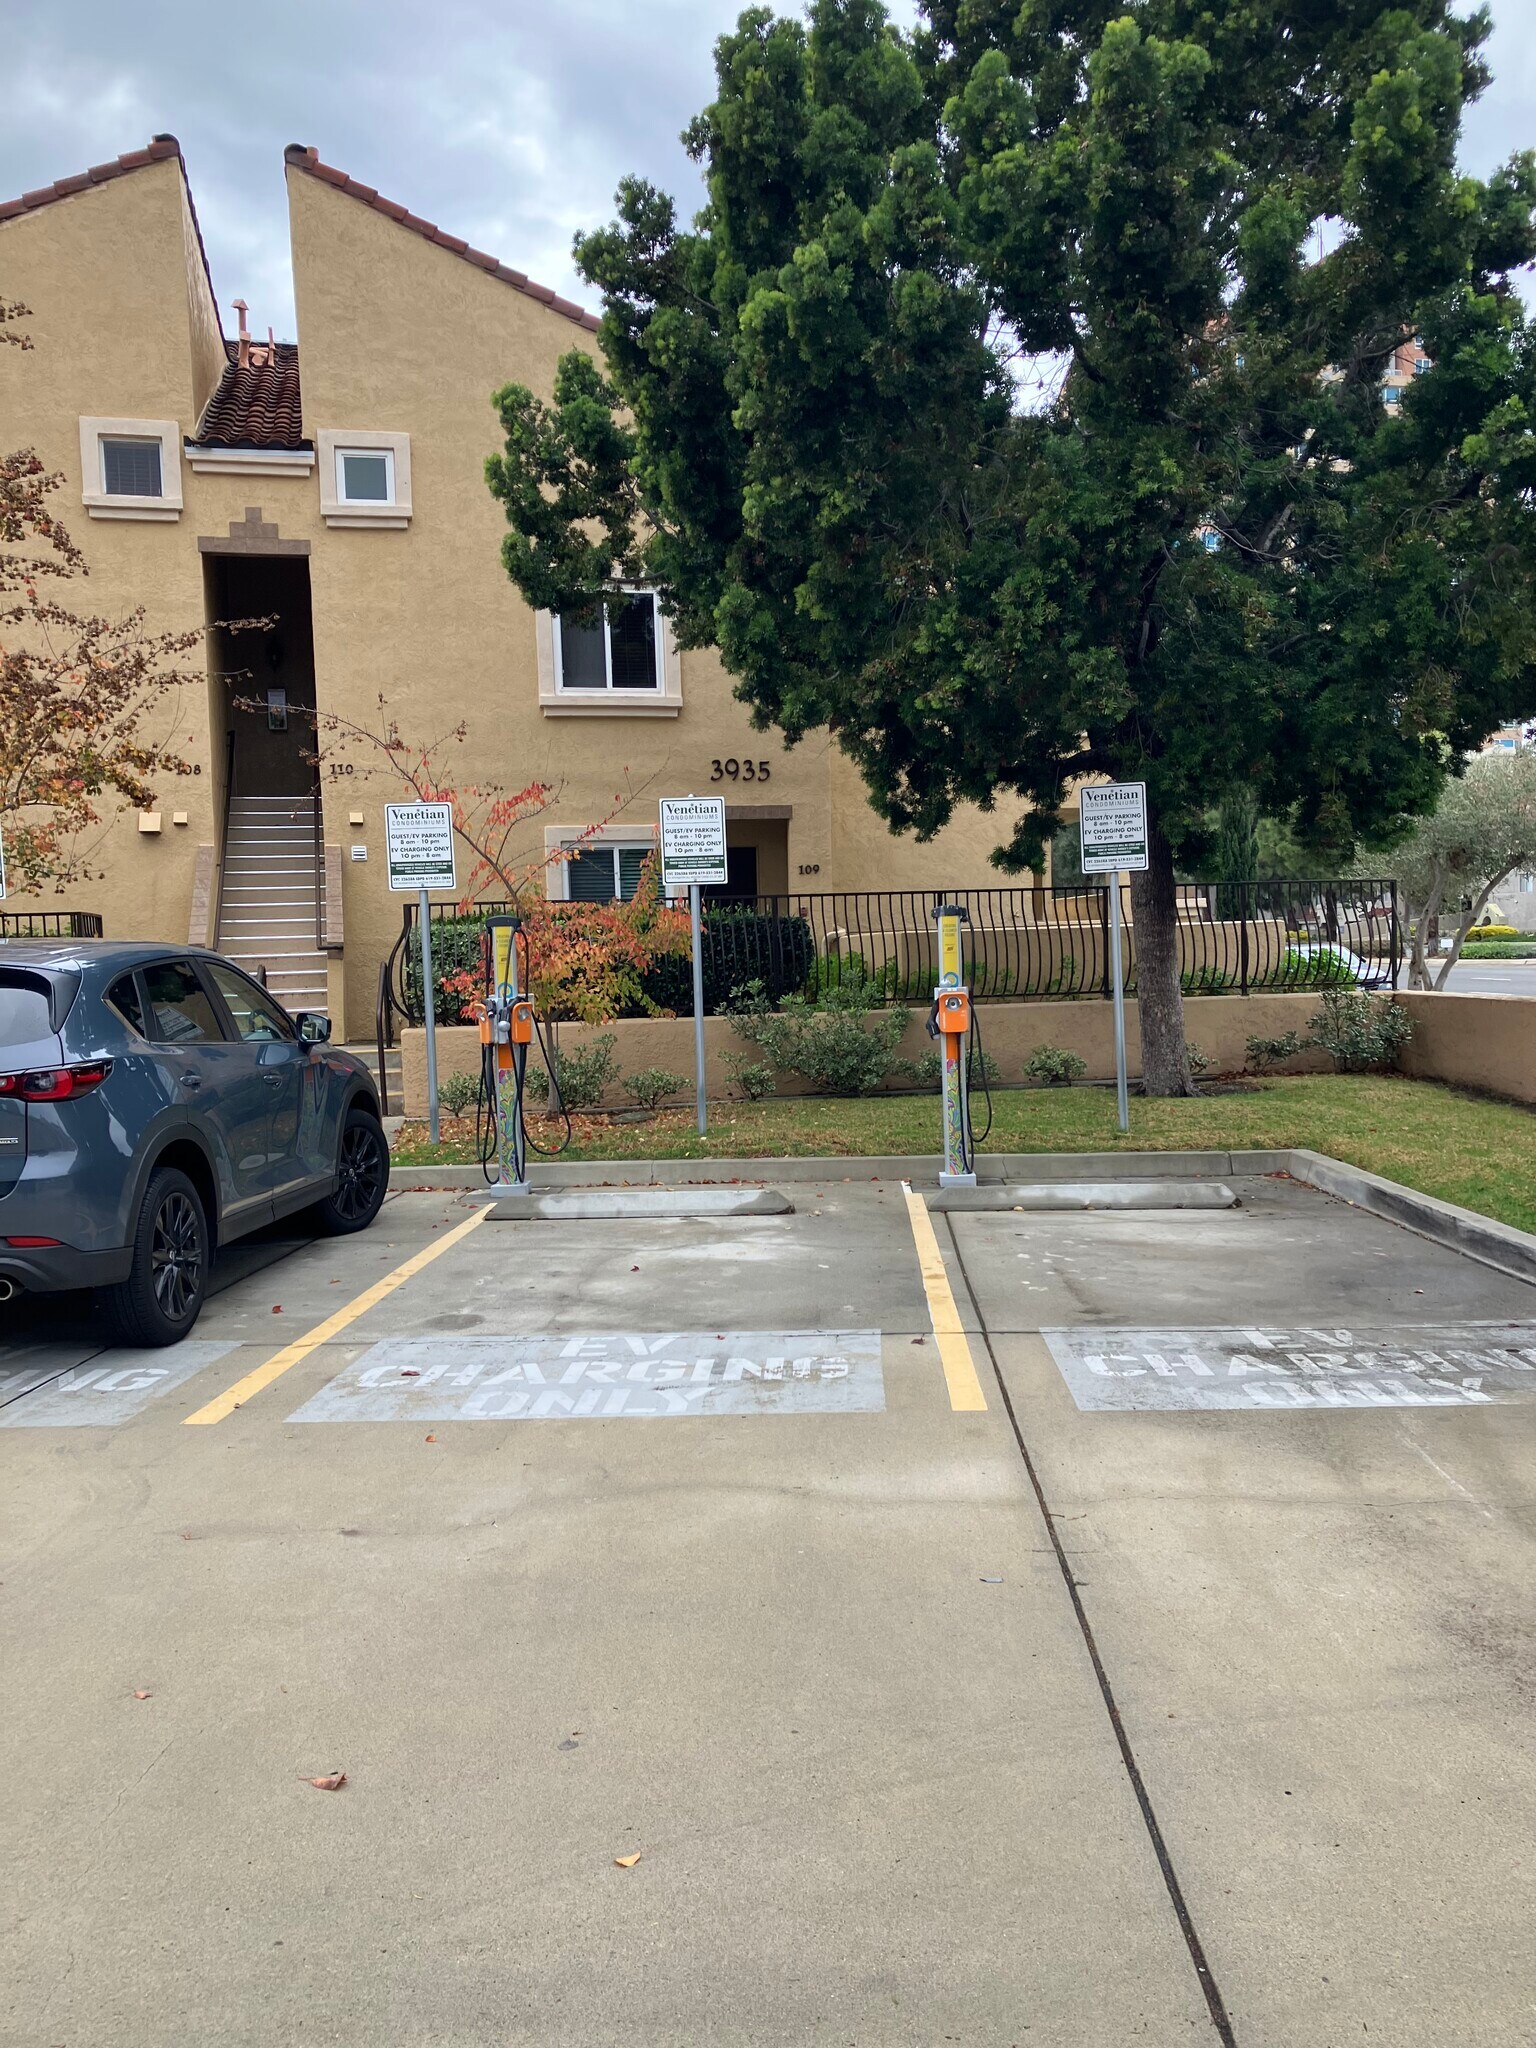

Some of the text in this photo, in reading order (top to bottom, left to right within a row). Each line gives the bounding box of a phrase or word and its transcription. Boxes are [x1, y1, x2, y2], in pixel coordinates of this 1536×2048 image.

[329, 763, 354, 775] 110
[711, 758, 770, 782] 3935
[1086, 800, 1139, 808] CONDOMINIUMS
[798, 864, 820, 876] 109
[559, 1335, 680, 1358] EV
[1239, 1327, 1354, 1350] EV
[356, 1356, 850, 1388] CHARGING
[1083, 1349, 1536, 1377] CHARGIN
[460, 1385, 717, 1416] ONLY
